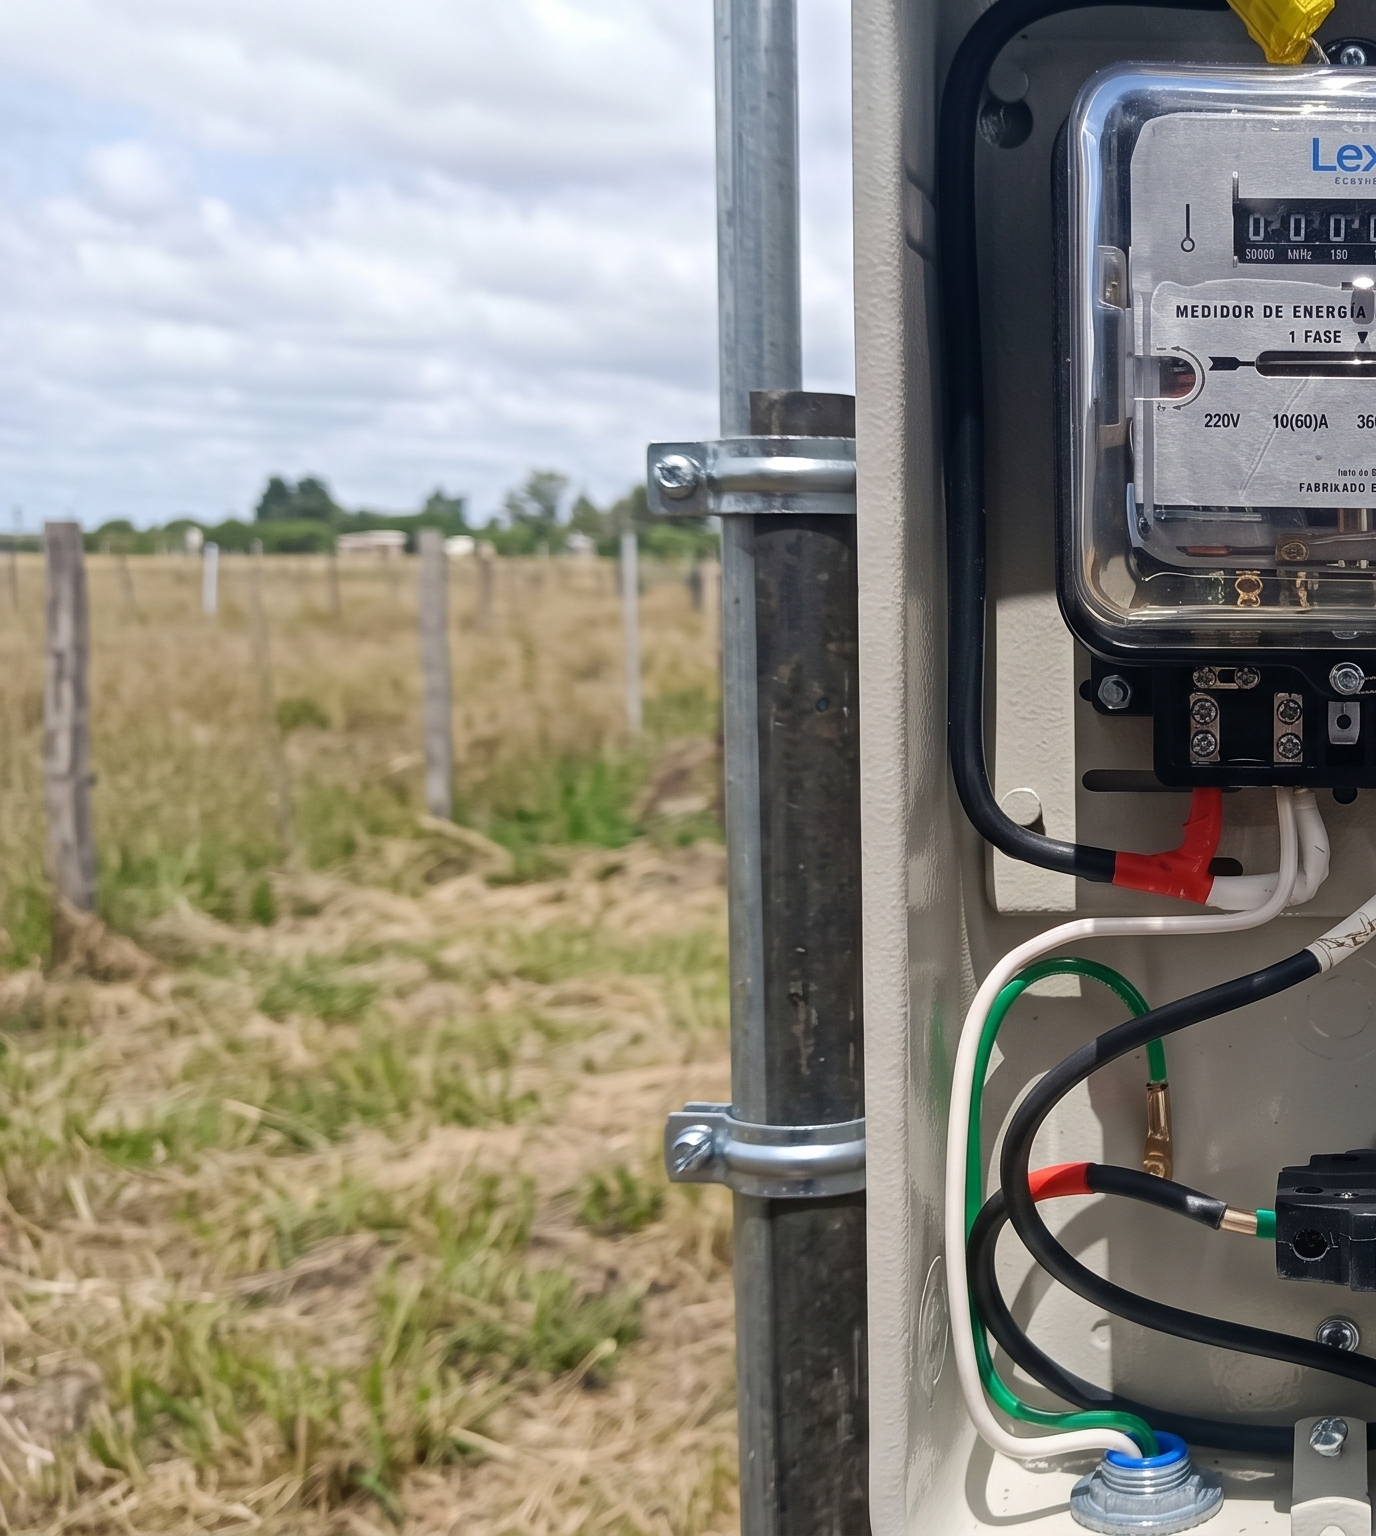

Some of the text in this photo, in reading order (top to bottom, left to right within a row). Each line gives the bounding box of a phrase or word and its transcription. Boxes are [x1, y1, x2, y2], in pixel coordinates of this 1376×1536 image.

[1176, 304, 1254, 319] MEDIDOR
[1263, 304, 1284, 319] DE
[1292, 301, 1366, 319] ENERGÍA
[1289, 330, 1342, 343] 1 FASE
[1204, 413, 1241, 429] 220V
[1272, 413, 1329, 432] 10(60)A
